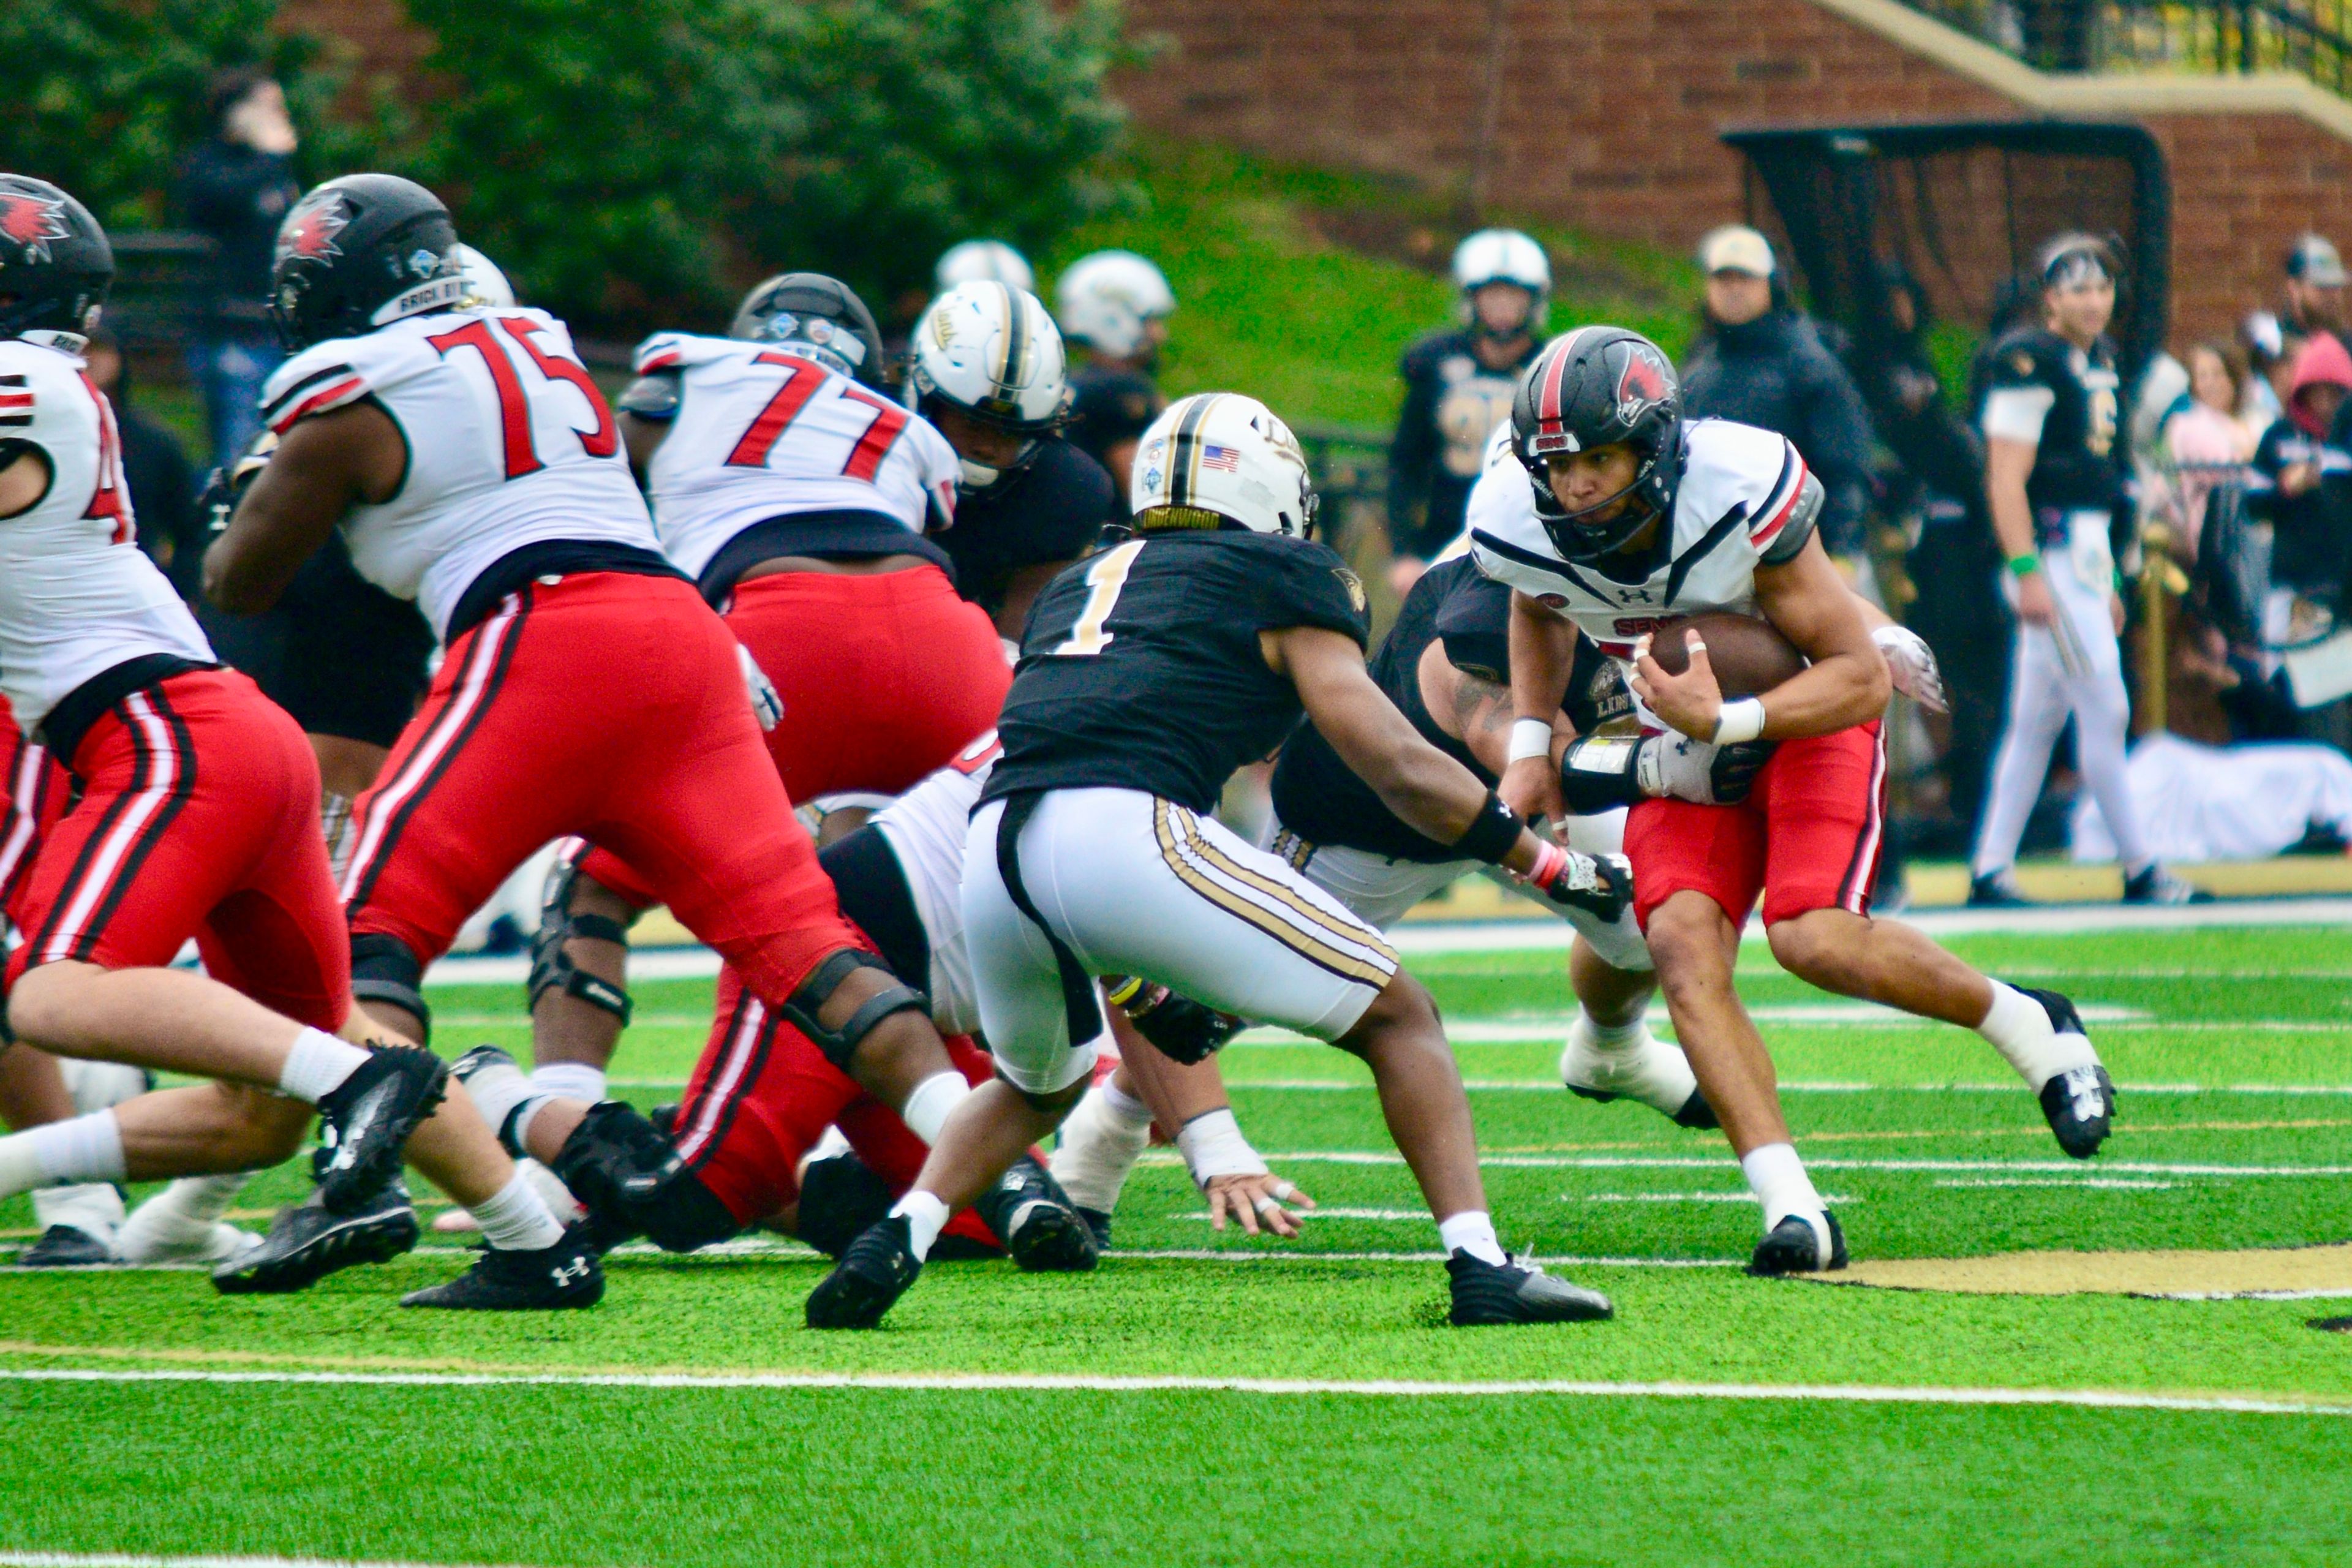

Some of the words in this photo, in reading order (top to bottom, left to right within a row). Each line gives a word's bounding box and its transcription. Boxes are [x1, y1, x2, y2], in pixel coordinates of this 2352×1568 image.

[426, 317, 619, 481] 75
[722, 352, 911, 485] 77
[1051, 538, 1147, 654] 1
[1613, 615, 1683, 637] SEM
